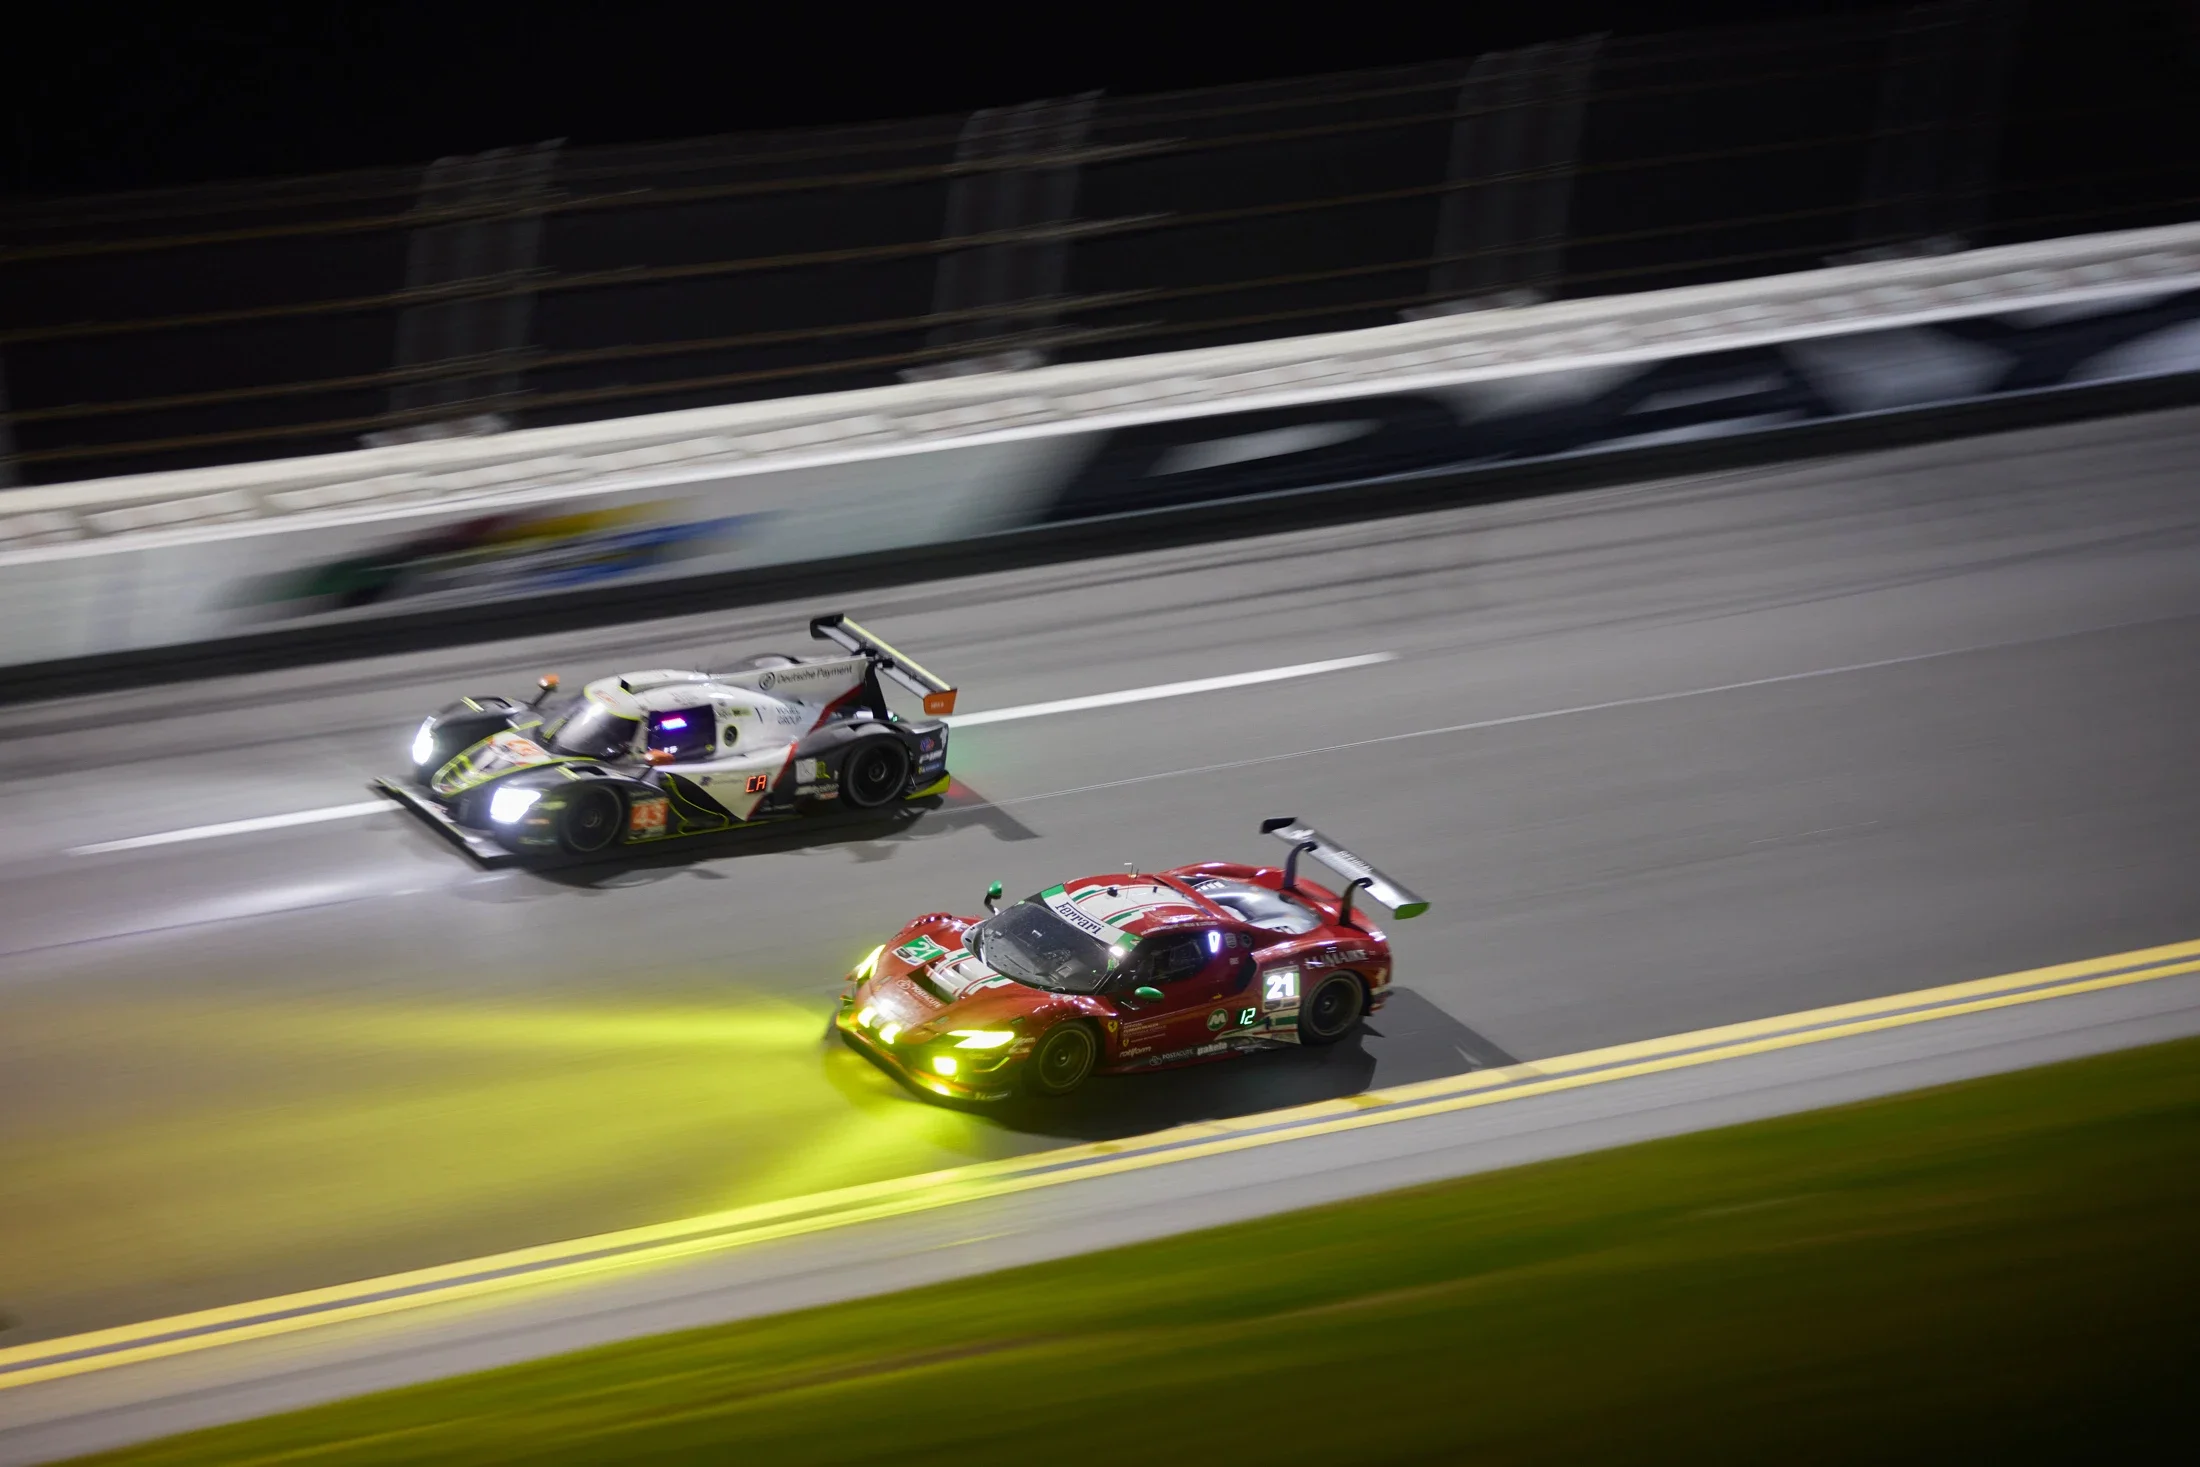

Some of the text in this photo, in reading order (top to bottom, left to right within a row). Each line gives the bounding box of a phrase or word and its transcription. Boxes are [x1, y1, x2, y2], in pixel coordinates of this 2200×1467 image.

[746, 775, 768, 794] CA
[1055, 902, 1105, 935] Ferrari
[906, 941, 941, 959] 21
[1266, 972, 1295, 1000] 21
[1240, 1007, 1256, 1025] 12
